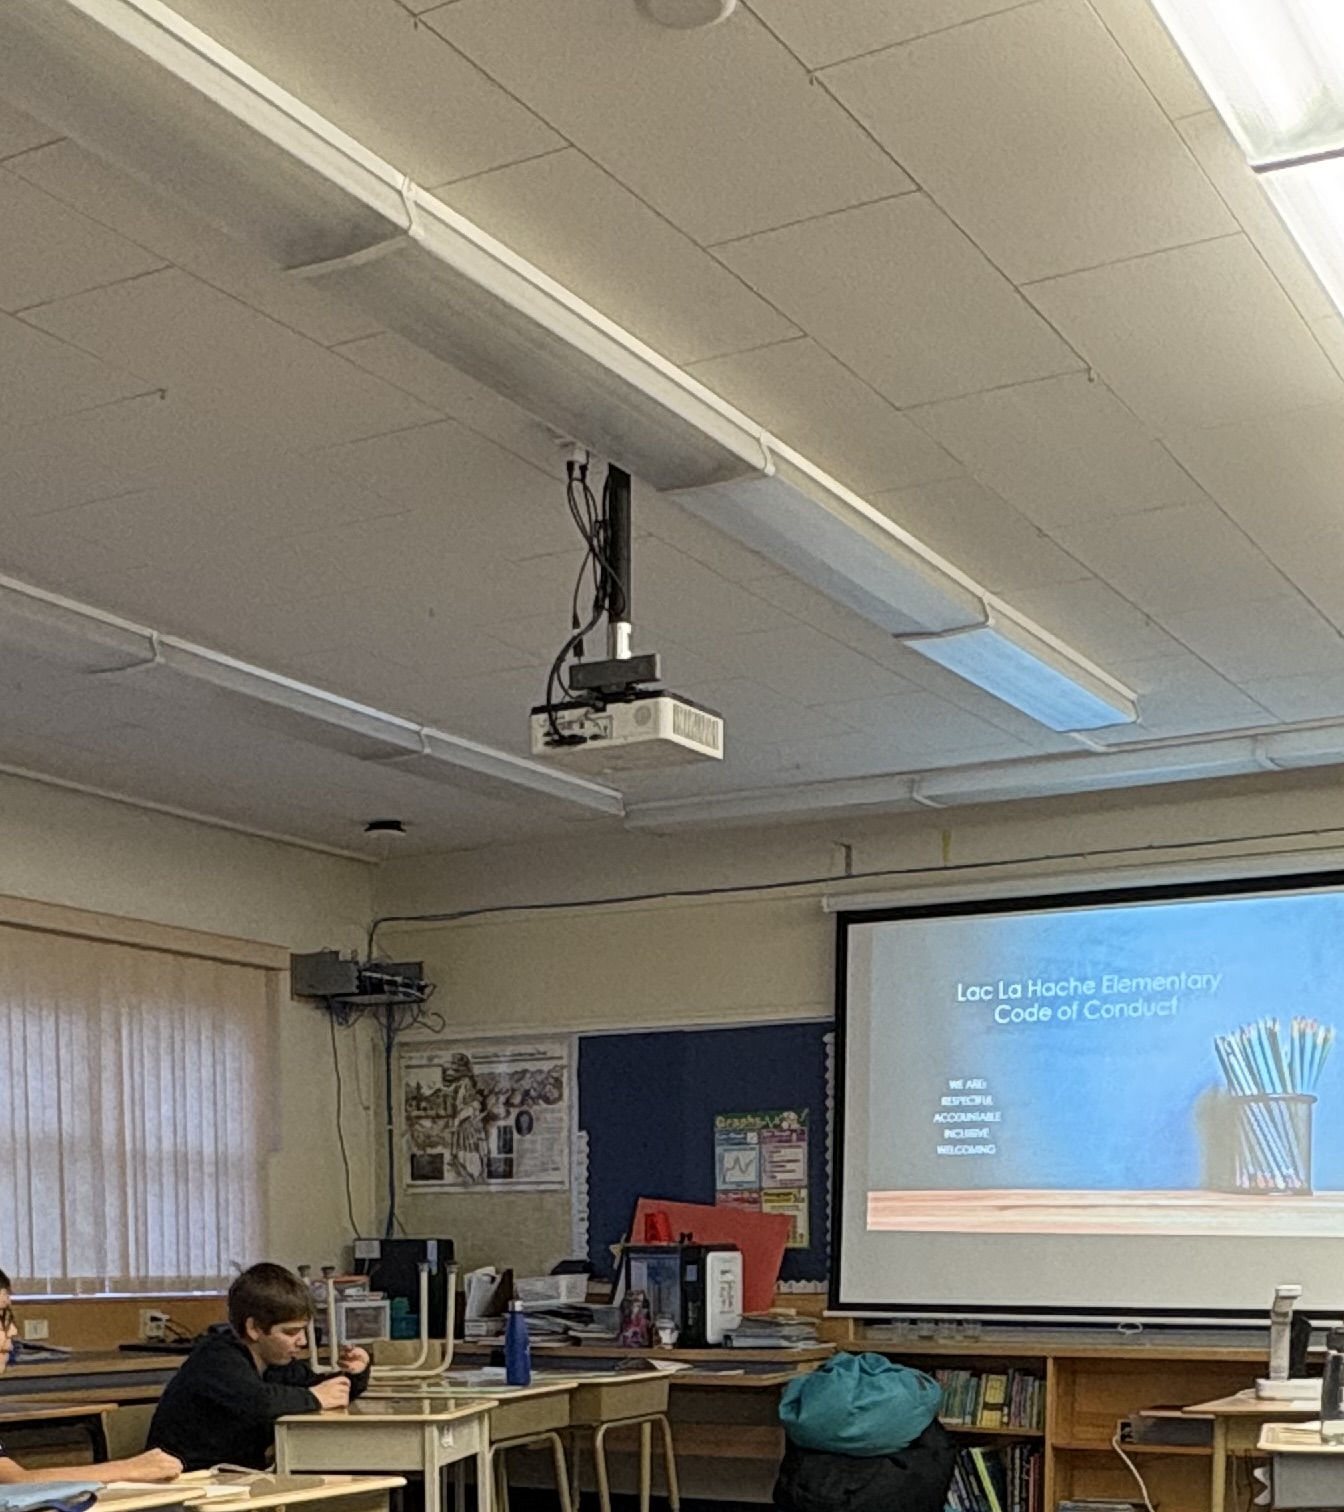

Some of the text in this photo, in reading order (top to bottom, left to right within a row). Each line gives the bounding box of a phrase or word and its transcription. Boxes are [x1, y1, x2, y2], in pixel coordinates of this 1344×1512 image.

[957, 971, 1223, 1002] Lac La Hache Elementary
[994, 996, 1179, 1024] Code of Conduct
[933, 1112, 1002, 1124] ACCOUNTABLE
[937, 1145, 996, 1156] WELCOMING
